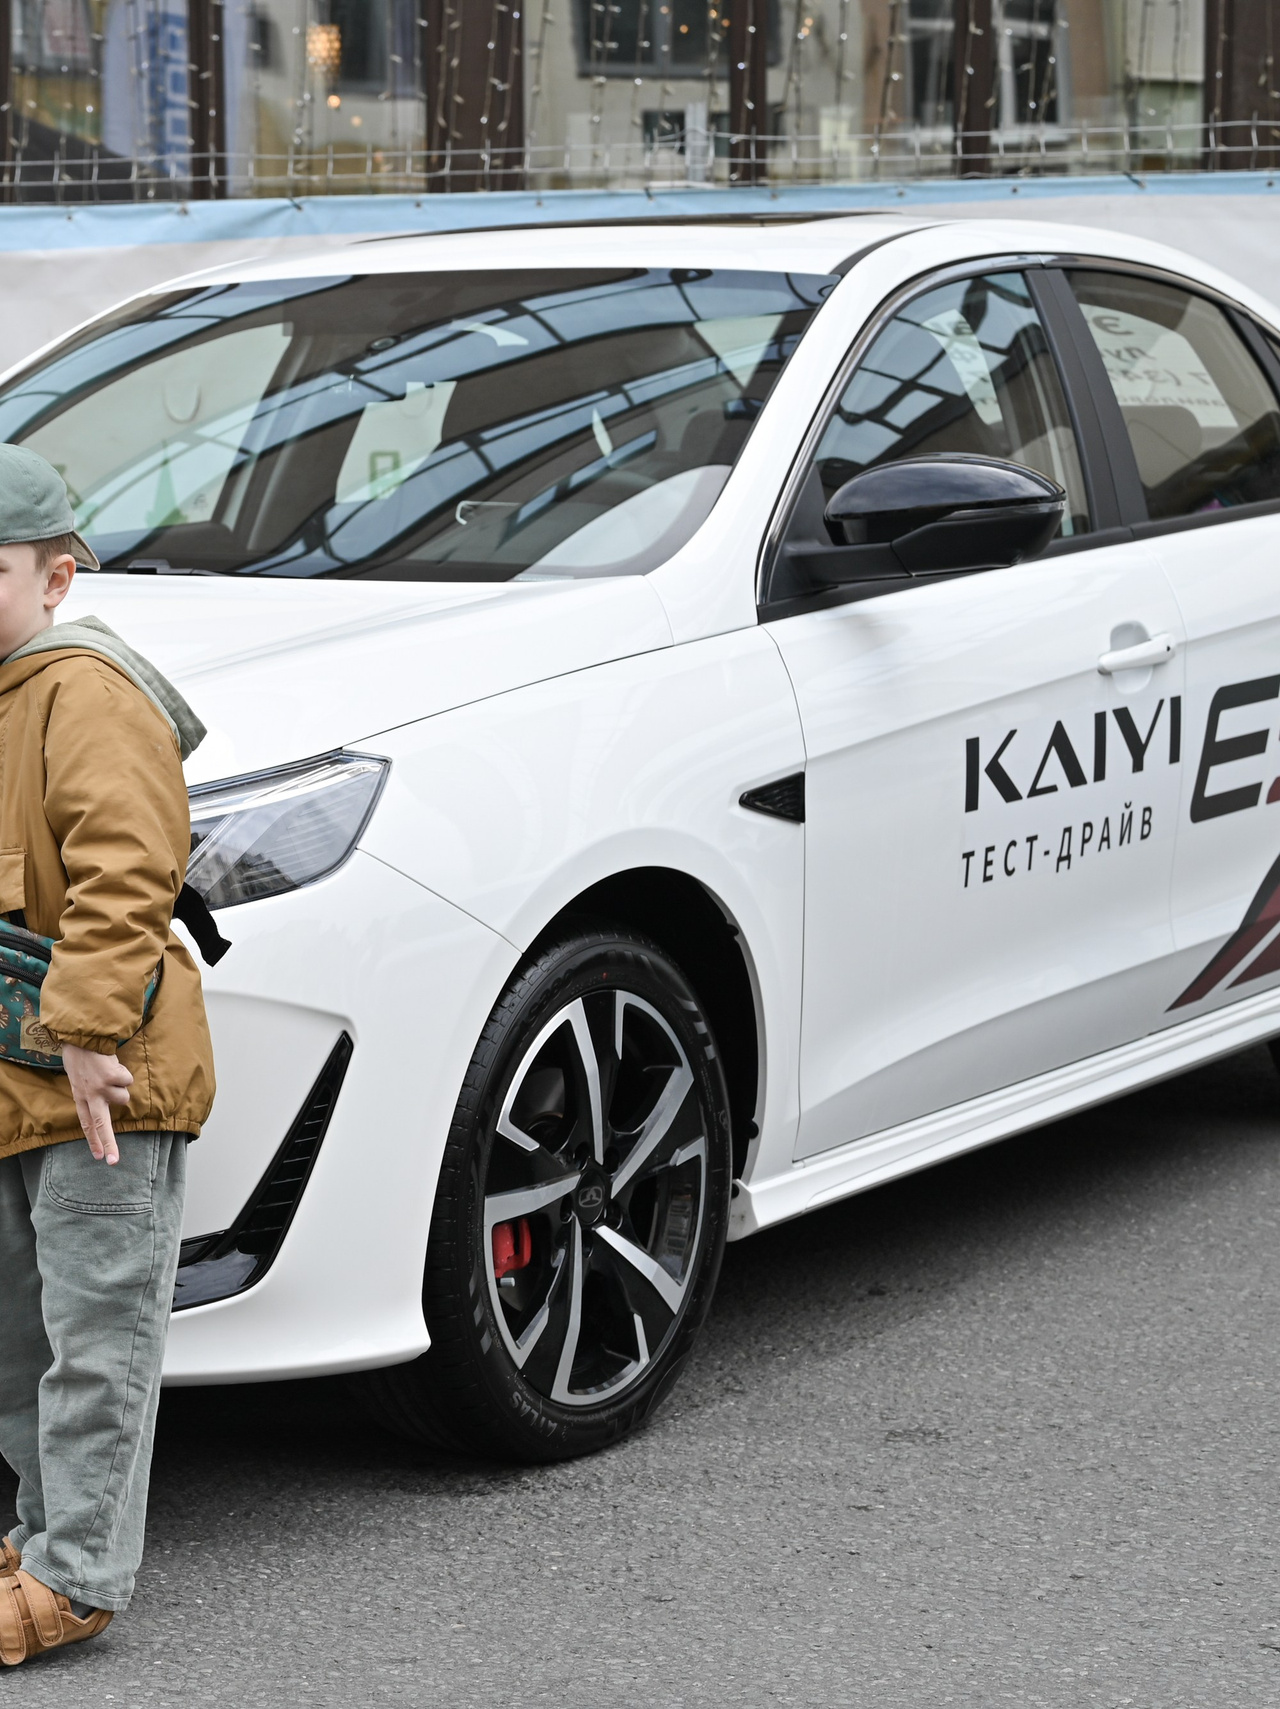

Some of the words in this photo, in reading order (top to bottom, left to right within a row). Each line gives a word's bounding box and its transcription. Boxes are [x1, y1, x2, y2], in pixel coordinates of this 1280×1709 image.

[964, 695, 1182, 813] KAIYI
[1190, 673, 1280, 824] E
[961, 801, 1153, 888] ТЕСТ-ДРАЙВ
